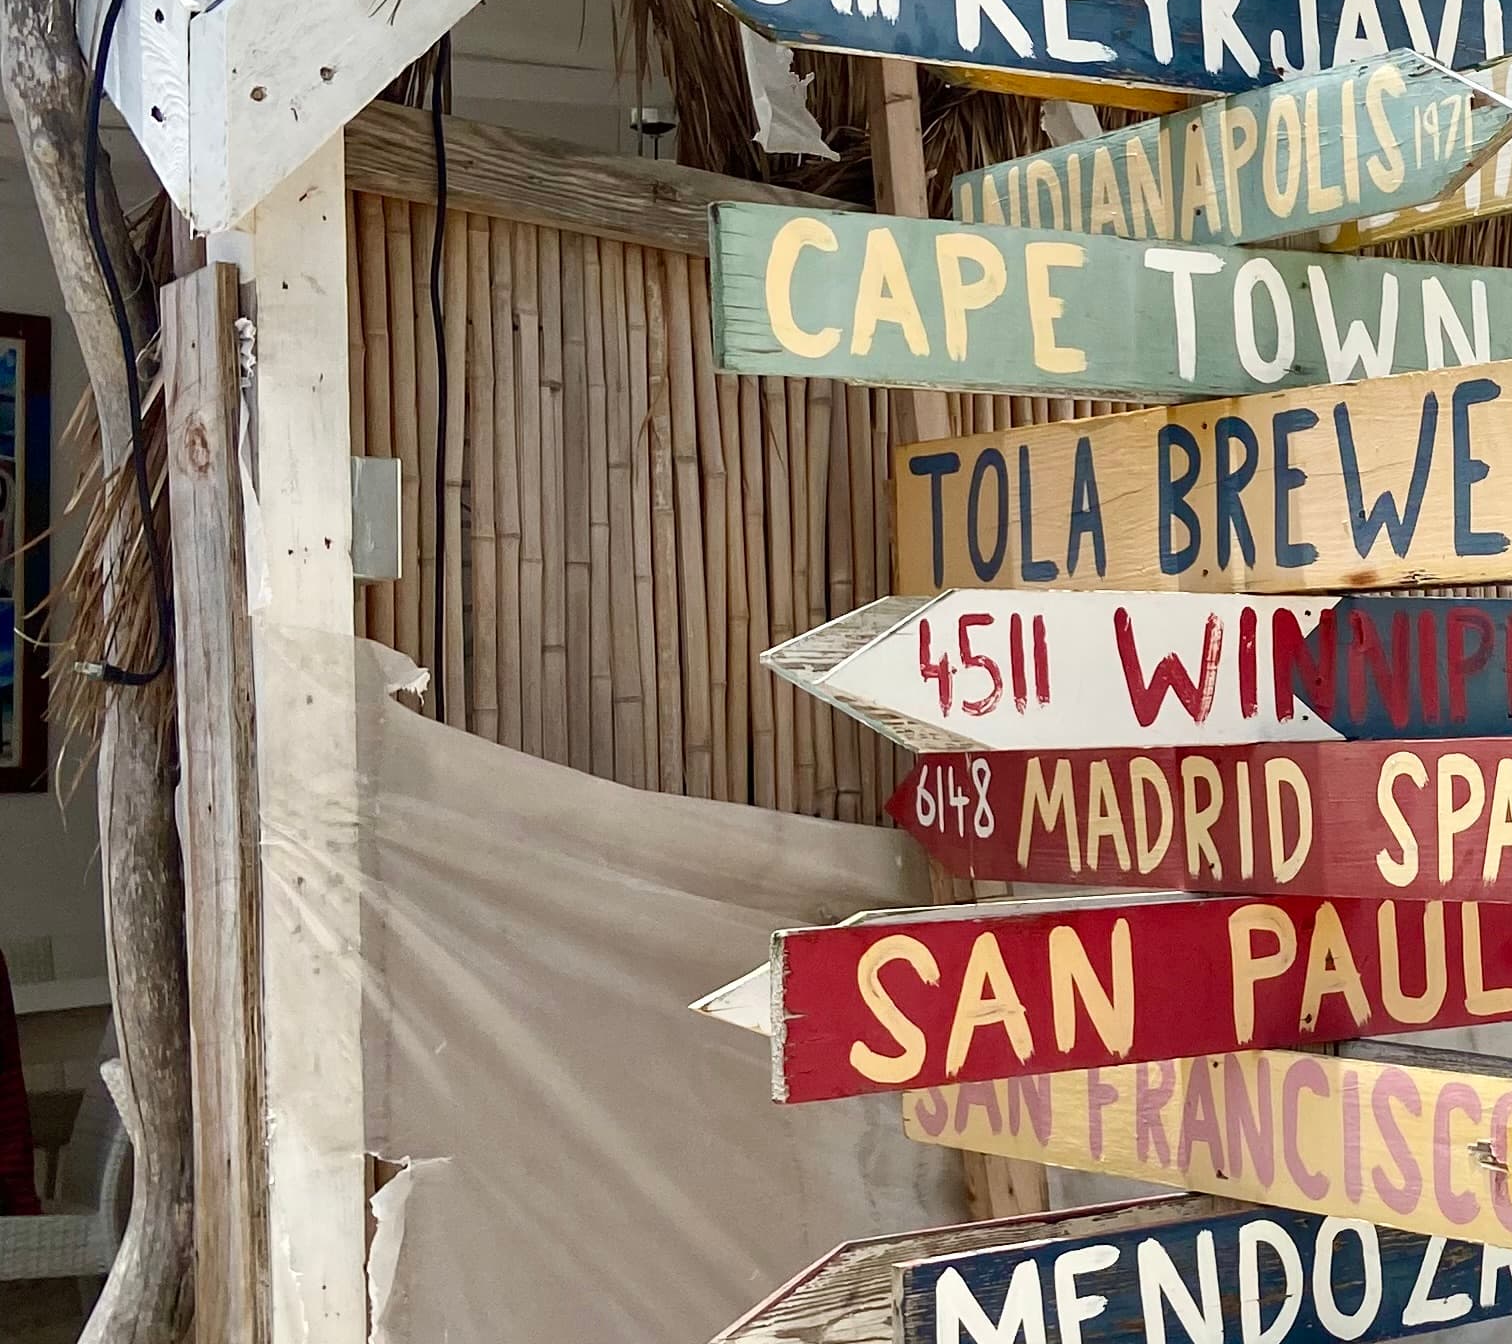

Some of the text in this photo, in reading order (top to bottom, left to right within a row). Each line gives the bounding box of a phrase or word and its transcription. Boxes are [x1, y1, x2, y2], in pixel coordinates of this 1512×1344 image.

[1414, 94, 1473, 169] 1971
[766, 217, 1088, 373] CAPE
[1144, 248, 1491, 383] TOWN
[910, 437, 1106, 588] TOLA
[920, 613, 1049, 717] 4511
[916, 758, 994, 838] 6148
[1017, 757, 1312, 884] MADRID
[850, 918, 1135, 1083] SAN
